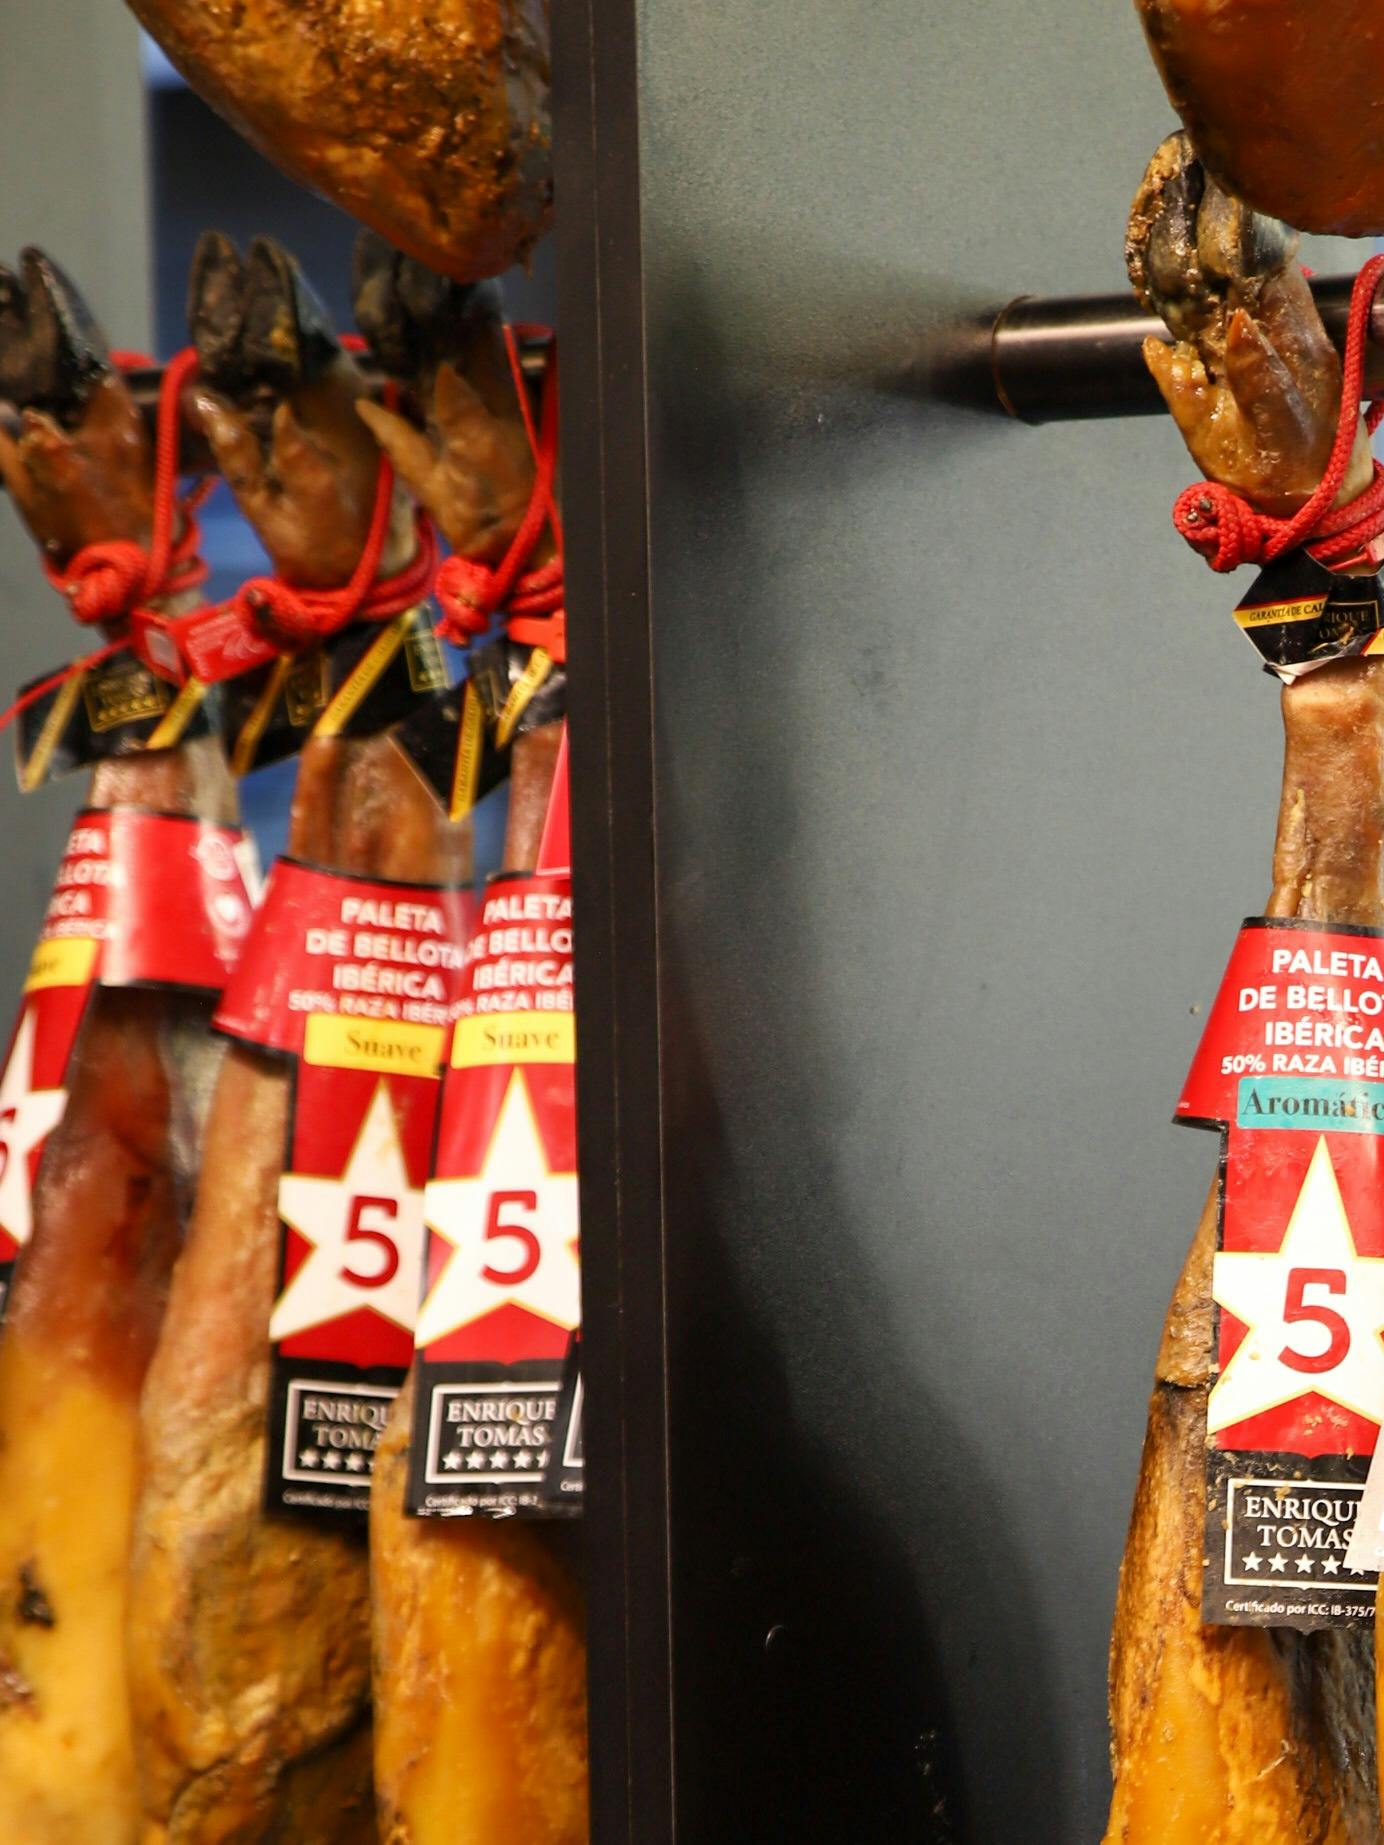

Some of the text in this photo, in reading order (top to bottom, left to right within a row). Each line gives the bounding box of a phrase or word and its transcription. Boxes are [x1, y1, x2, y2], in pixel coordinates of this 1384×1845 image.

[340, 897, 446, 935] PALETA
[305, 927, 349, 957] DE
[333, 960, 447, 1000] IBÉRICA
[1272, 949, 1384, 982] PALETA
[288, 989, 337, 1014] 50%
[339, 993, 401, 1020] RAZA
[476, 990, 529, 1013] RAZA
[1238, 985, 1277, 1012] DE
[345, 1029, 423, 1061] Suave
[482, 1026, 560, 1051] Suave
[1221, 1054, 1266, 1075] 50%
[1272, 1053, 1336, 1075] RAZA
[340, 1195, 399, 1287] 5
[481, 1191, 541, 1286] 5
[1277, 1268, 1351, 1374] 5
[1225, 1600, 1285, 1615] Certificado
[1286, 1604, 1306, 1616] por
